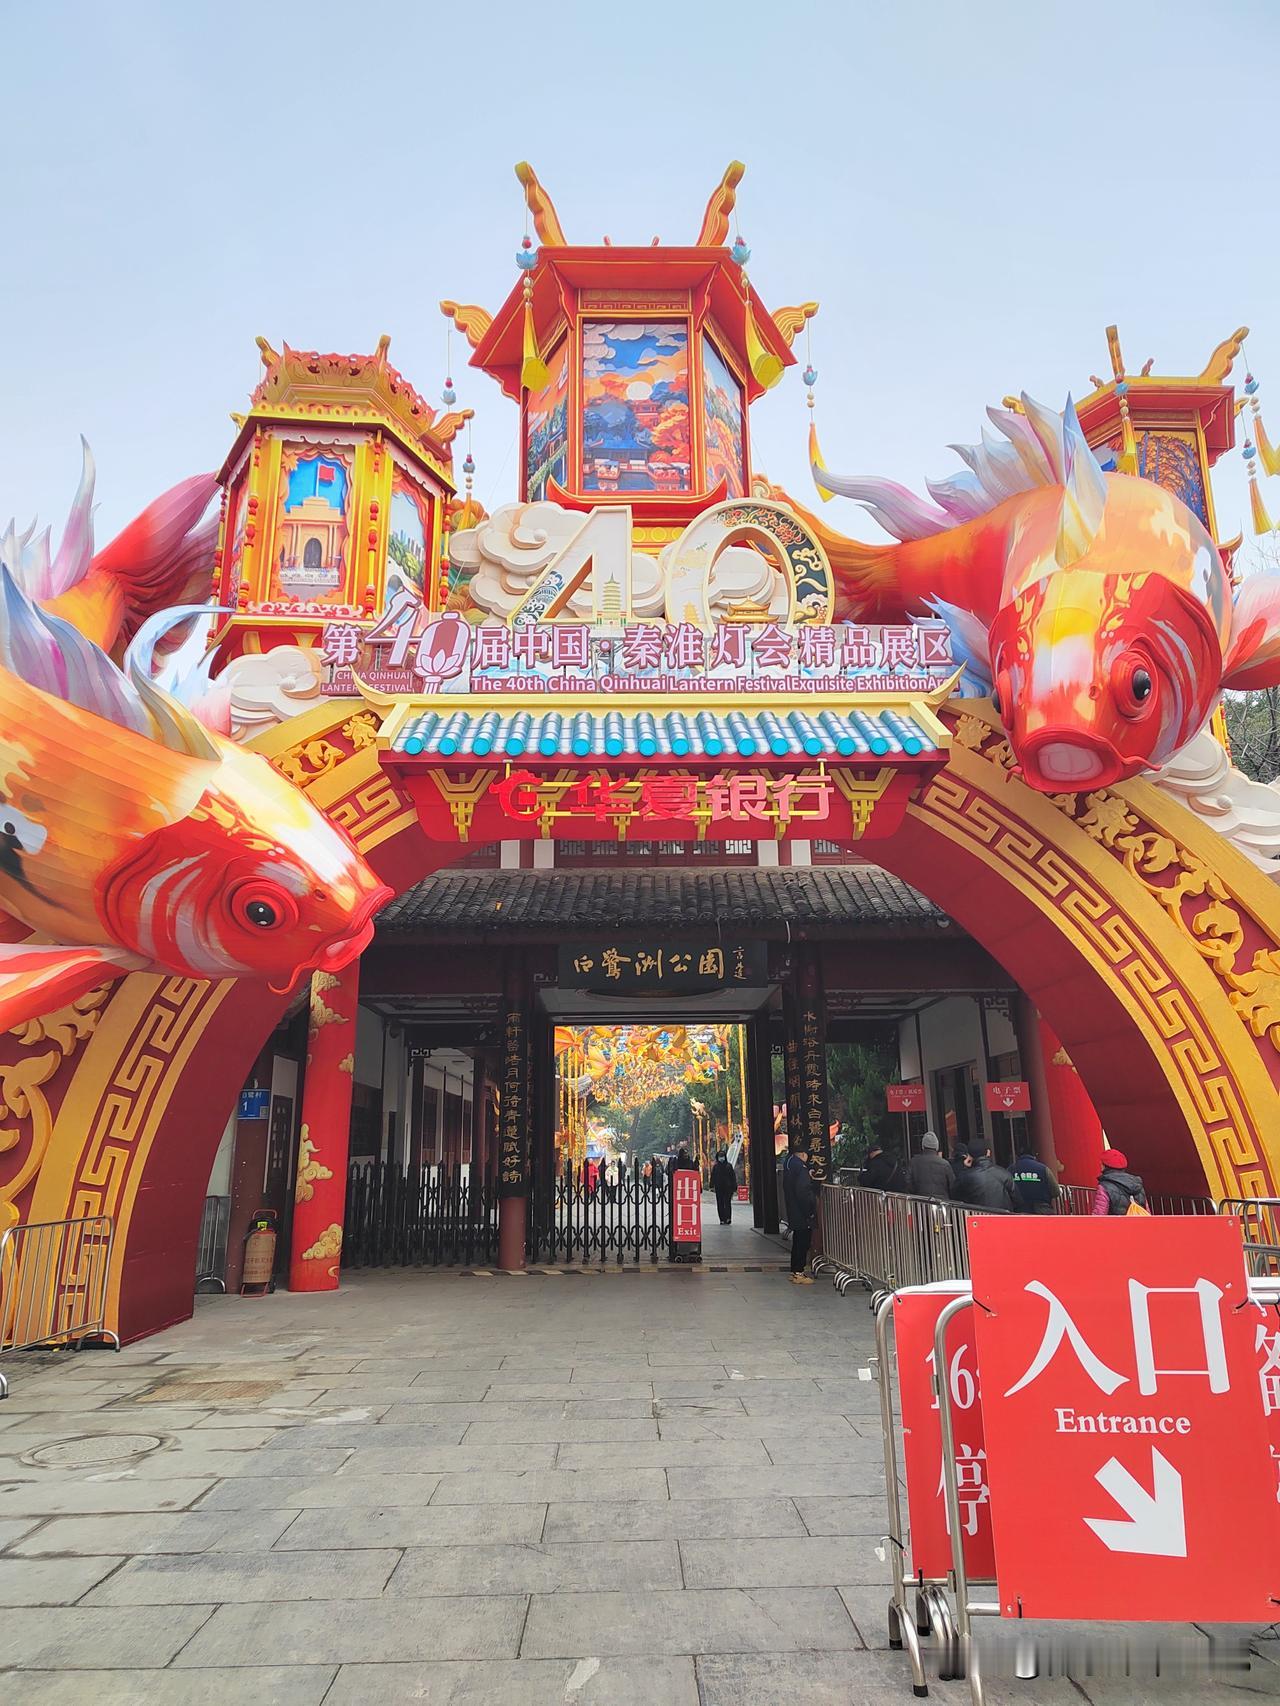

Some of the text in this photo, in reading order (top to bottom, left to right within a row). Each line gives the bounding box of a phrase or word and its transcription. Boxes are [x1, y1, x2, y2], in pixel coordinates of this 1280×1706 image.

[369, 671, 411, 681] QINHUAI
[471, 676, 502, 691] The
[506, 676, 545, 691] 40th
[548, 676, 597, 691] China
[600, 675, 667, 693] Qinhuai
[669, 676, 735, 691] Lantern
[570, 773, 835, 821] 华夏银行
[243, 1101, 248, 1111] 1
[676, 1177, 698, 1226] 出口
[677, 1227, 697, 1236] Exit
[1003, 1277, 1231, 1397] 入口
[1054, 1408, 1191, 1434] Entrance
